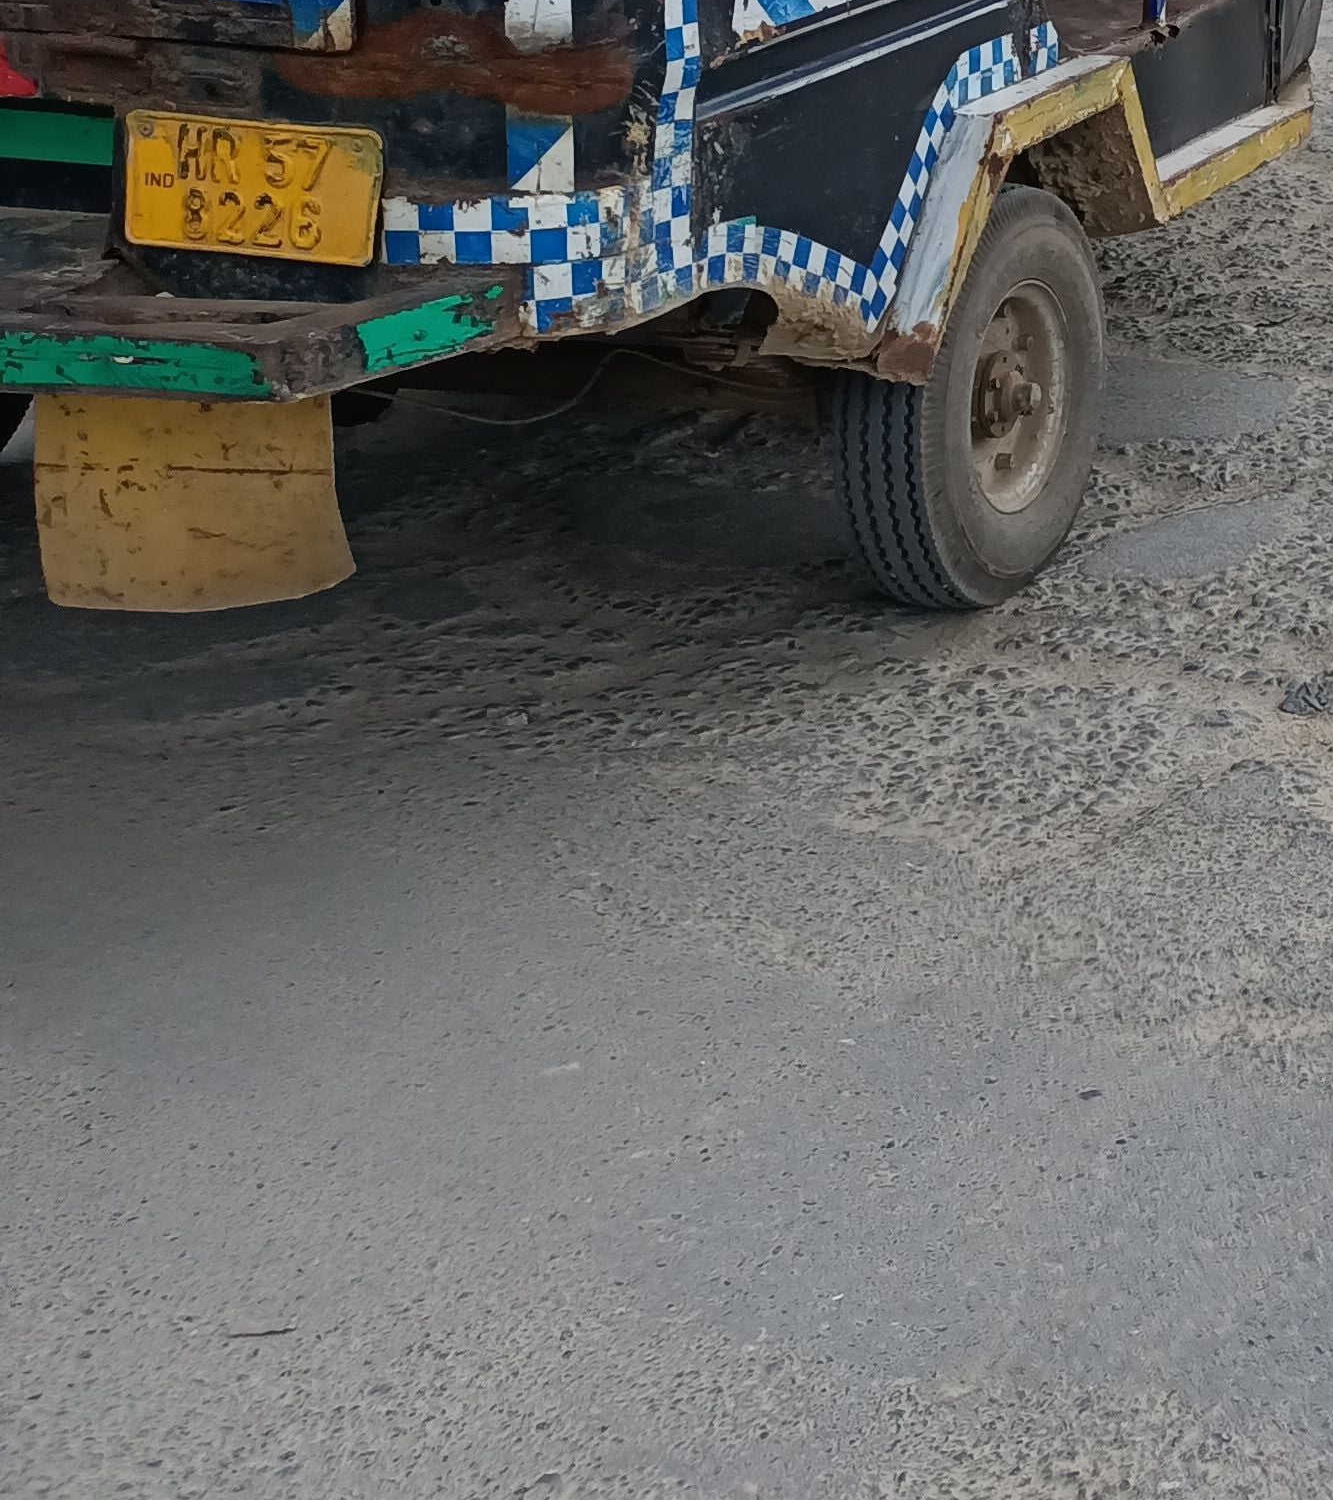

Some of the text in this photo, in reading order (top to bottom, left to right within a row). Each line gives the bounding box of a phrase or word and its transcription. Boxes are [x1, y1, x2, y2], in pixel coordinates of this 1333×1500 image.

[144, 172, 175, 188] IND
[177, 124, 331, 191] HR 57
[184, 187, 321, 250] 8226
